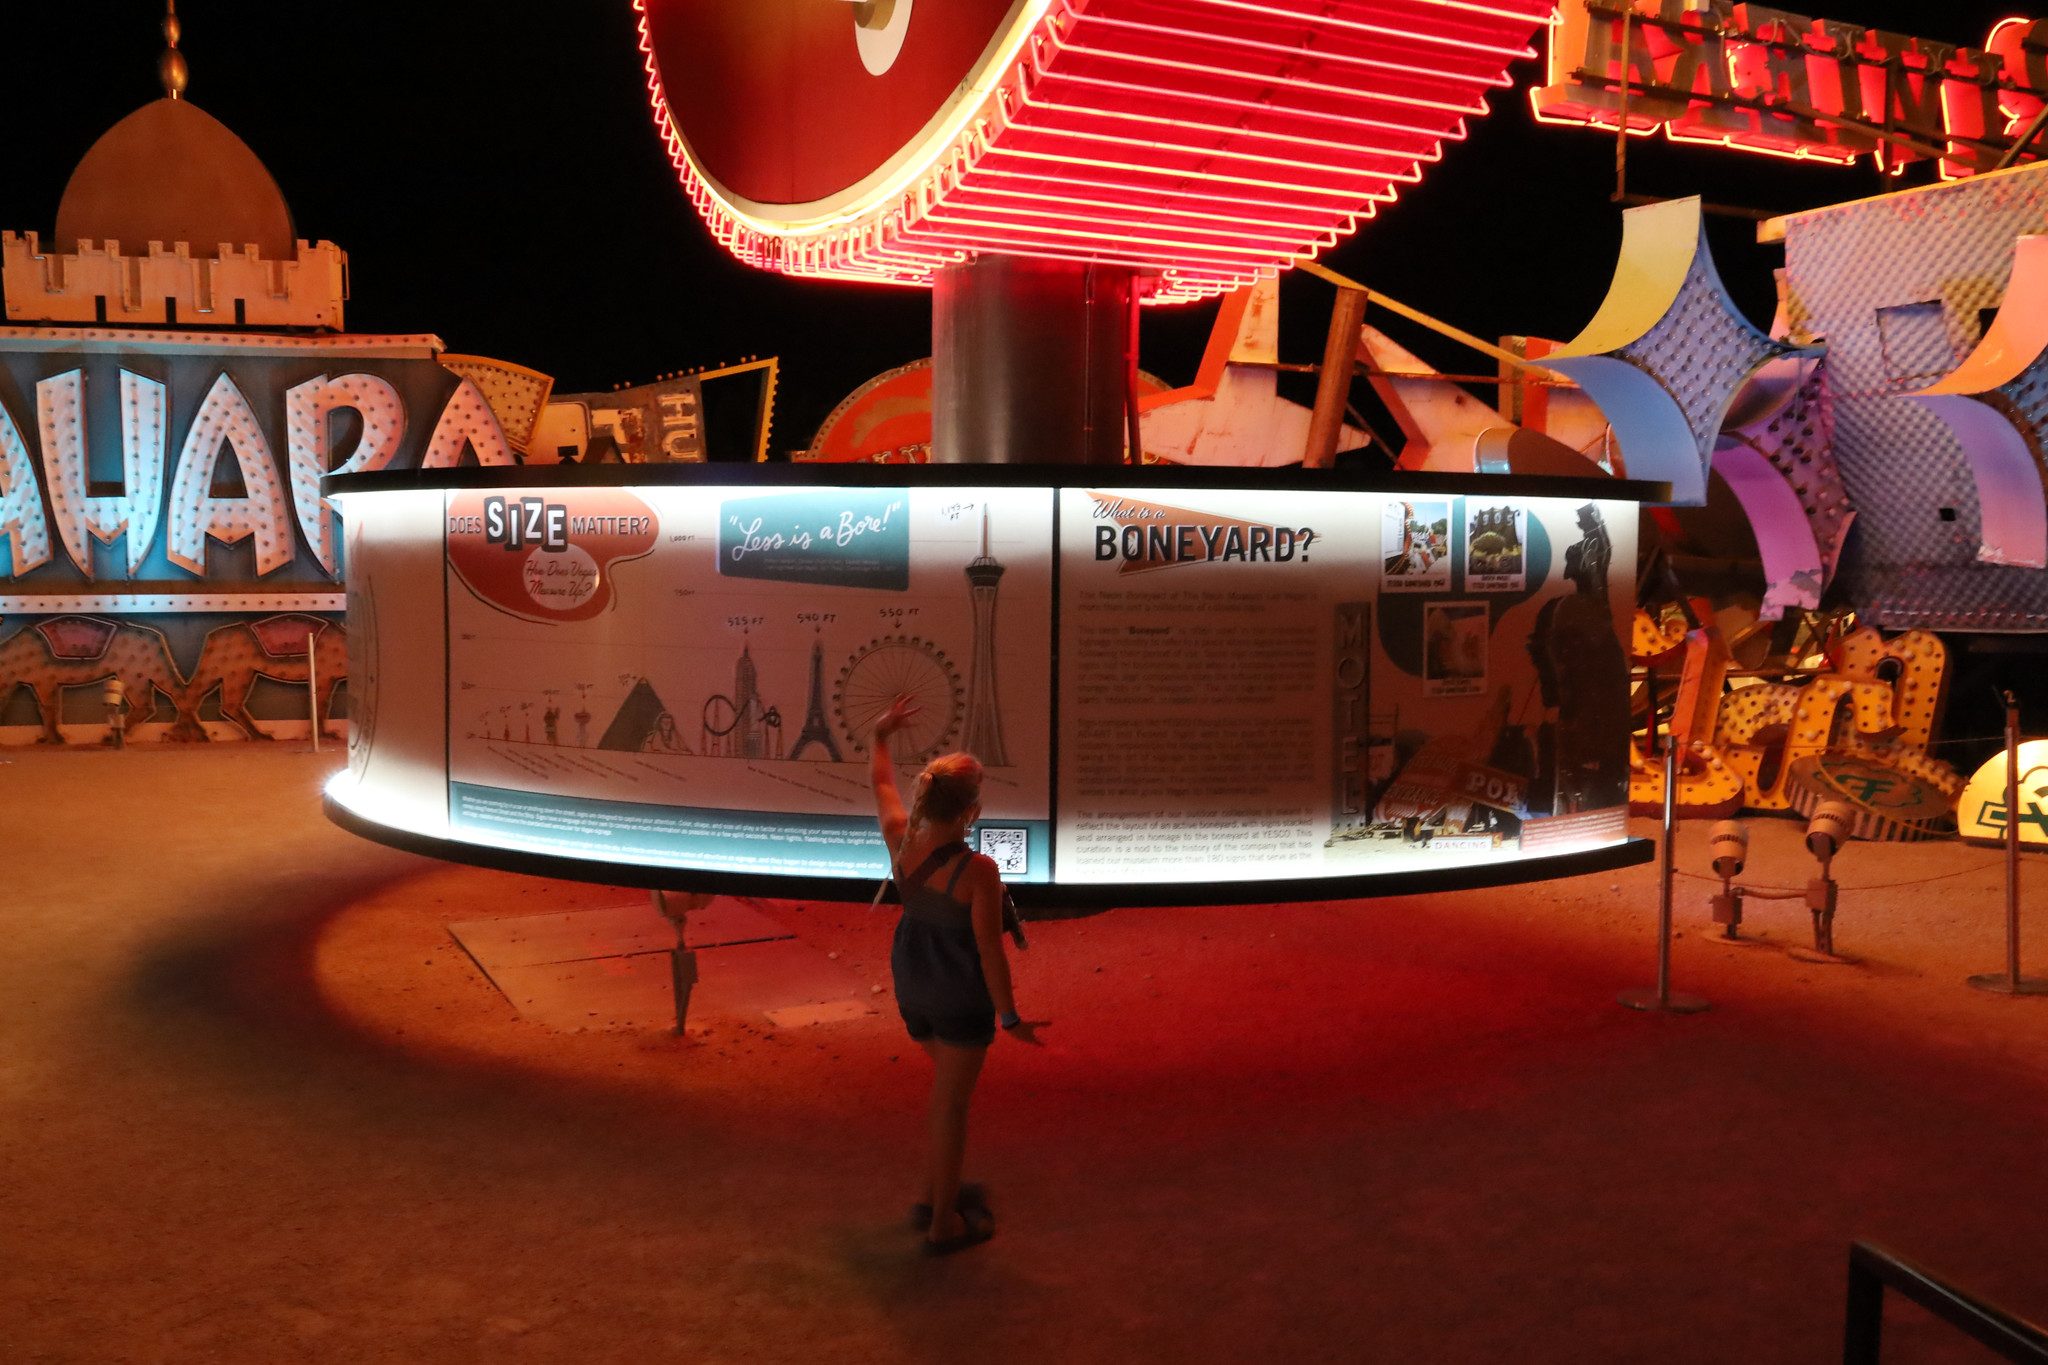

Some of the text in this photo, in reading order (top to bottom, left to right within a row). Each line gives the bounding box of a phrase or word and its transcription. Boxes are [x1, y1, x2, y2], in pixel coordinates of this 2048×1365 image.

[1092, 498, 1164, 519] What is a
[449, 501, 649, 546] DOES SIZE MATTER?
[789, 525, 812, 550] is
[820, 526, 834, 540] a
[1095, 525, 1314, 562] BONEYARD?
[569, 582, 592, 603] Up?
[752, 617, 764, 625] FT
[797, 613, 836, 623] 540 FT
[879, 608, 919, 617] 550 FT
[1337, 612, 1365, 815] MOTEL
